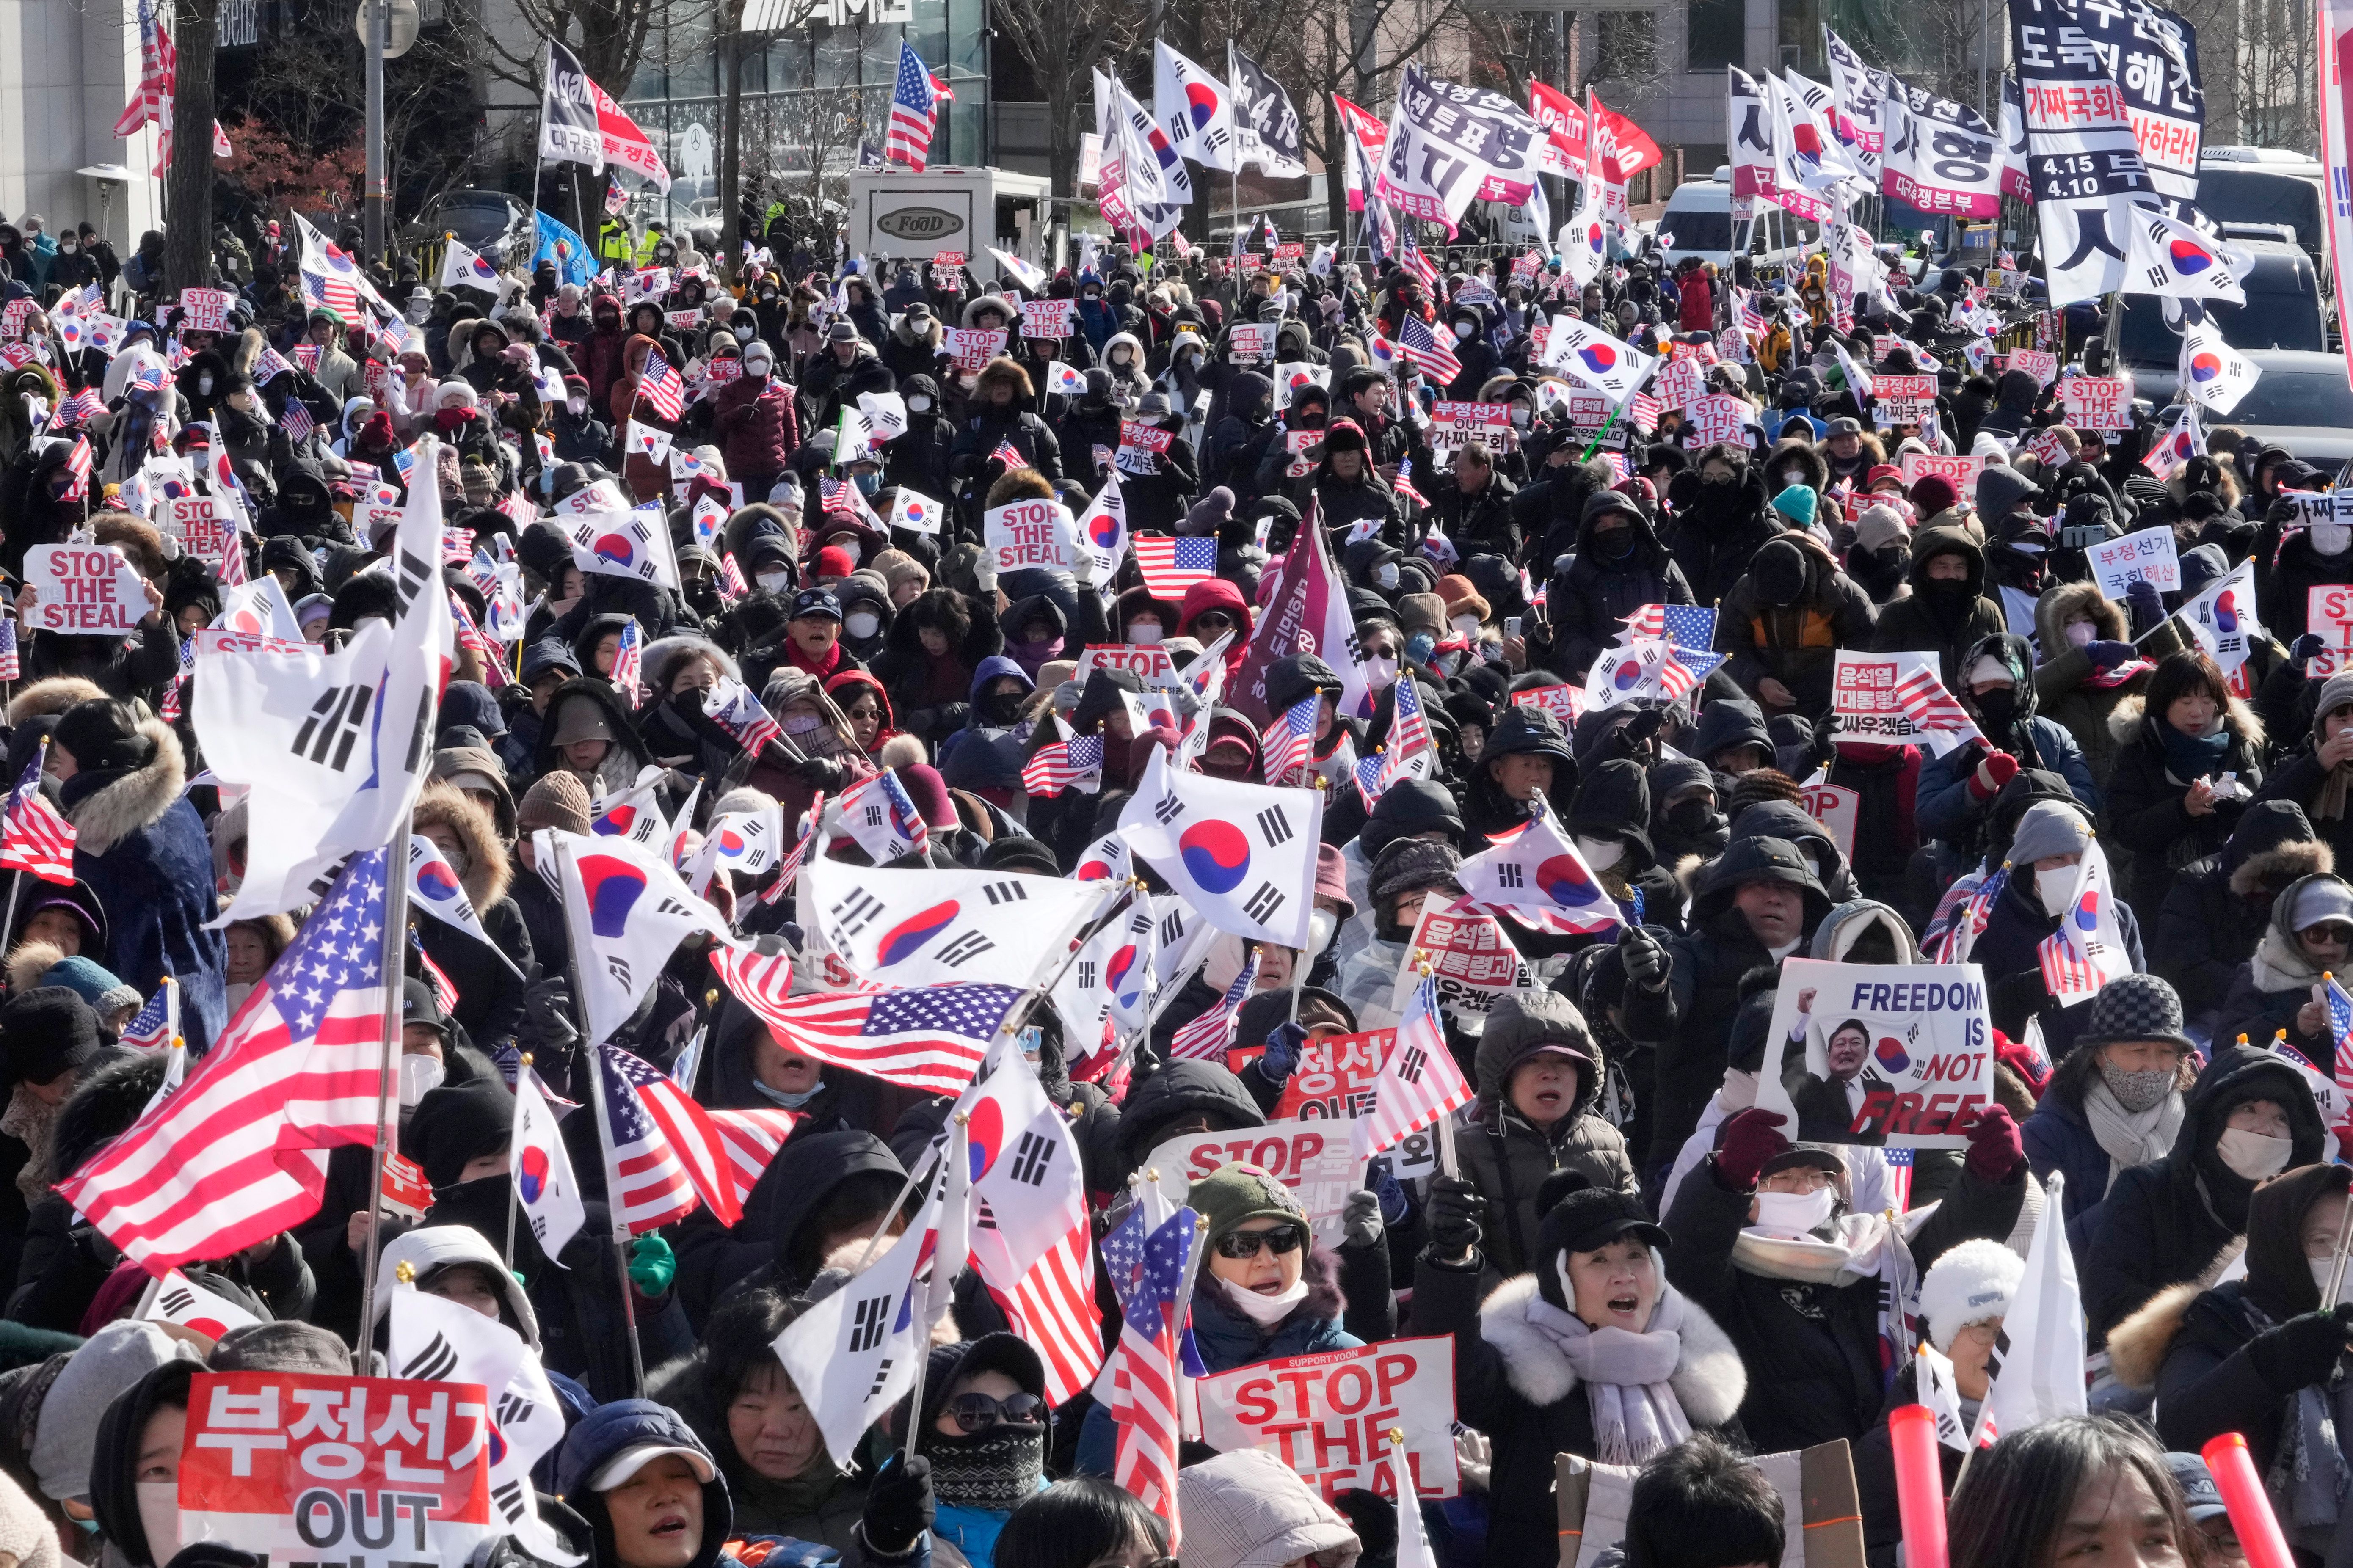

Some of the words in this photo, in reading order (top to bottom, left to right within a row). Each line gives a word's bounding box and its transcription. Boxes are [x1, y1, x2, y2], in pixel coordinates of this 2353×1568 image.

[1531, 93, 1584, 142] Again
[2043, 155, 2095, 174] 4.15
[1896, 176, 1972, 211] 대구투쟁본부
[2048, 177, 2099, 196] 4.10
[187, 290, 228, 306] STOP
[1548, 289, 1580, 300] SAL
[191, 303, 224, 318] THE
[671, 312, 697, 322] STOP
[1026, 302, 1068, 314] STOP
[11, 314, 26, 324] TH
[181, 316, 232, 333] STEAL
[1031, 313, 1062, 325] THE
[1, 324, 26, 336] STE
[1023, 324, 1071, 337] STEAL
[954, 332, 999, 347] STOP
[1722, 339, 1741, 350] THE
[960, 344, 992, 358] THE
[951, 356, 989, 371] STEA
[2017, 353, 2054, 368] STOP
[1661, 376, 1697, 393] THE
[1874, 377, 1935, 394] 부정선거
[2072, 382, 2125, 397] STOP
[1572, 399, 1603, 412] 윤석열
[1654, 390, 1702, 410] STEA
[1696, 397, 1746, 416] STOP
[1890, 395, 1917, 404] OUT
[2078, 398, 2118, 413] THE
[1435, 402, 1507, 421] 부정선거
[1701, 412, 1740, 429] THE
[1874, 405, 1934, 422] 가짜국회
[1454, 418, 1487, 430] OUT
[2066, 413, 2130, 429] STEAL
[1122, 422, 1171, 449] 부정선거
[1688, 427, 1751, 447] STEAL
[1133, 443, 1149, 456] OUT
[1914, 460, 1972, 478] STOP
[2200, 470, 2210, 484] A
[174, 501, 213, 520] STO
[1002, 505, 1059, 527] STOP
[183, 520, 223, 536] THE
[1012, 525, 1054, 545] THE
[175, 537, 223, 555] TEA
[2100, 536, 2171, 566] 부정선거
[50, 551, 126, 577] STOP
[1000, 545, 1068, 567] STEAL
[60, 578, 116, 603] THE
[44, 604, 135, 628] STEAL
[1091, 652, 1172, 679] STOP
[1840, 667, 1893, 687] 윤석열
[1840, 689, 1899, 711] 대통령
[1426, 919, 1498, 950] 윤석열
[1851, 982, 1983, 1011] FREEDOM
[1965, 1018, 1985, 1046] IS
[1922, 1054, 1986, 1081] NOT
[1849, 1091, 1987, 1135] FREE
[1187, 1133, 1324, 1180] STOP
[1288, 1356, 1331, 1368] SUPPORT
[1332, 1350, 1359, 1363] YOON
[1235, 1353, 1418, 1425] STOP
[1261, 1407, 1401, 1470] THE
[294, 1485, 441, 1552] OUT
